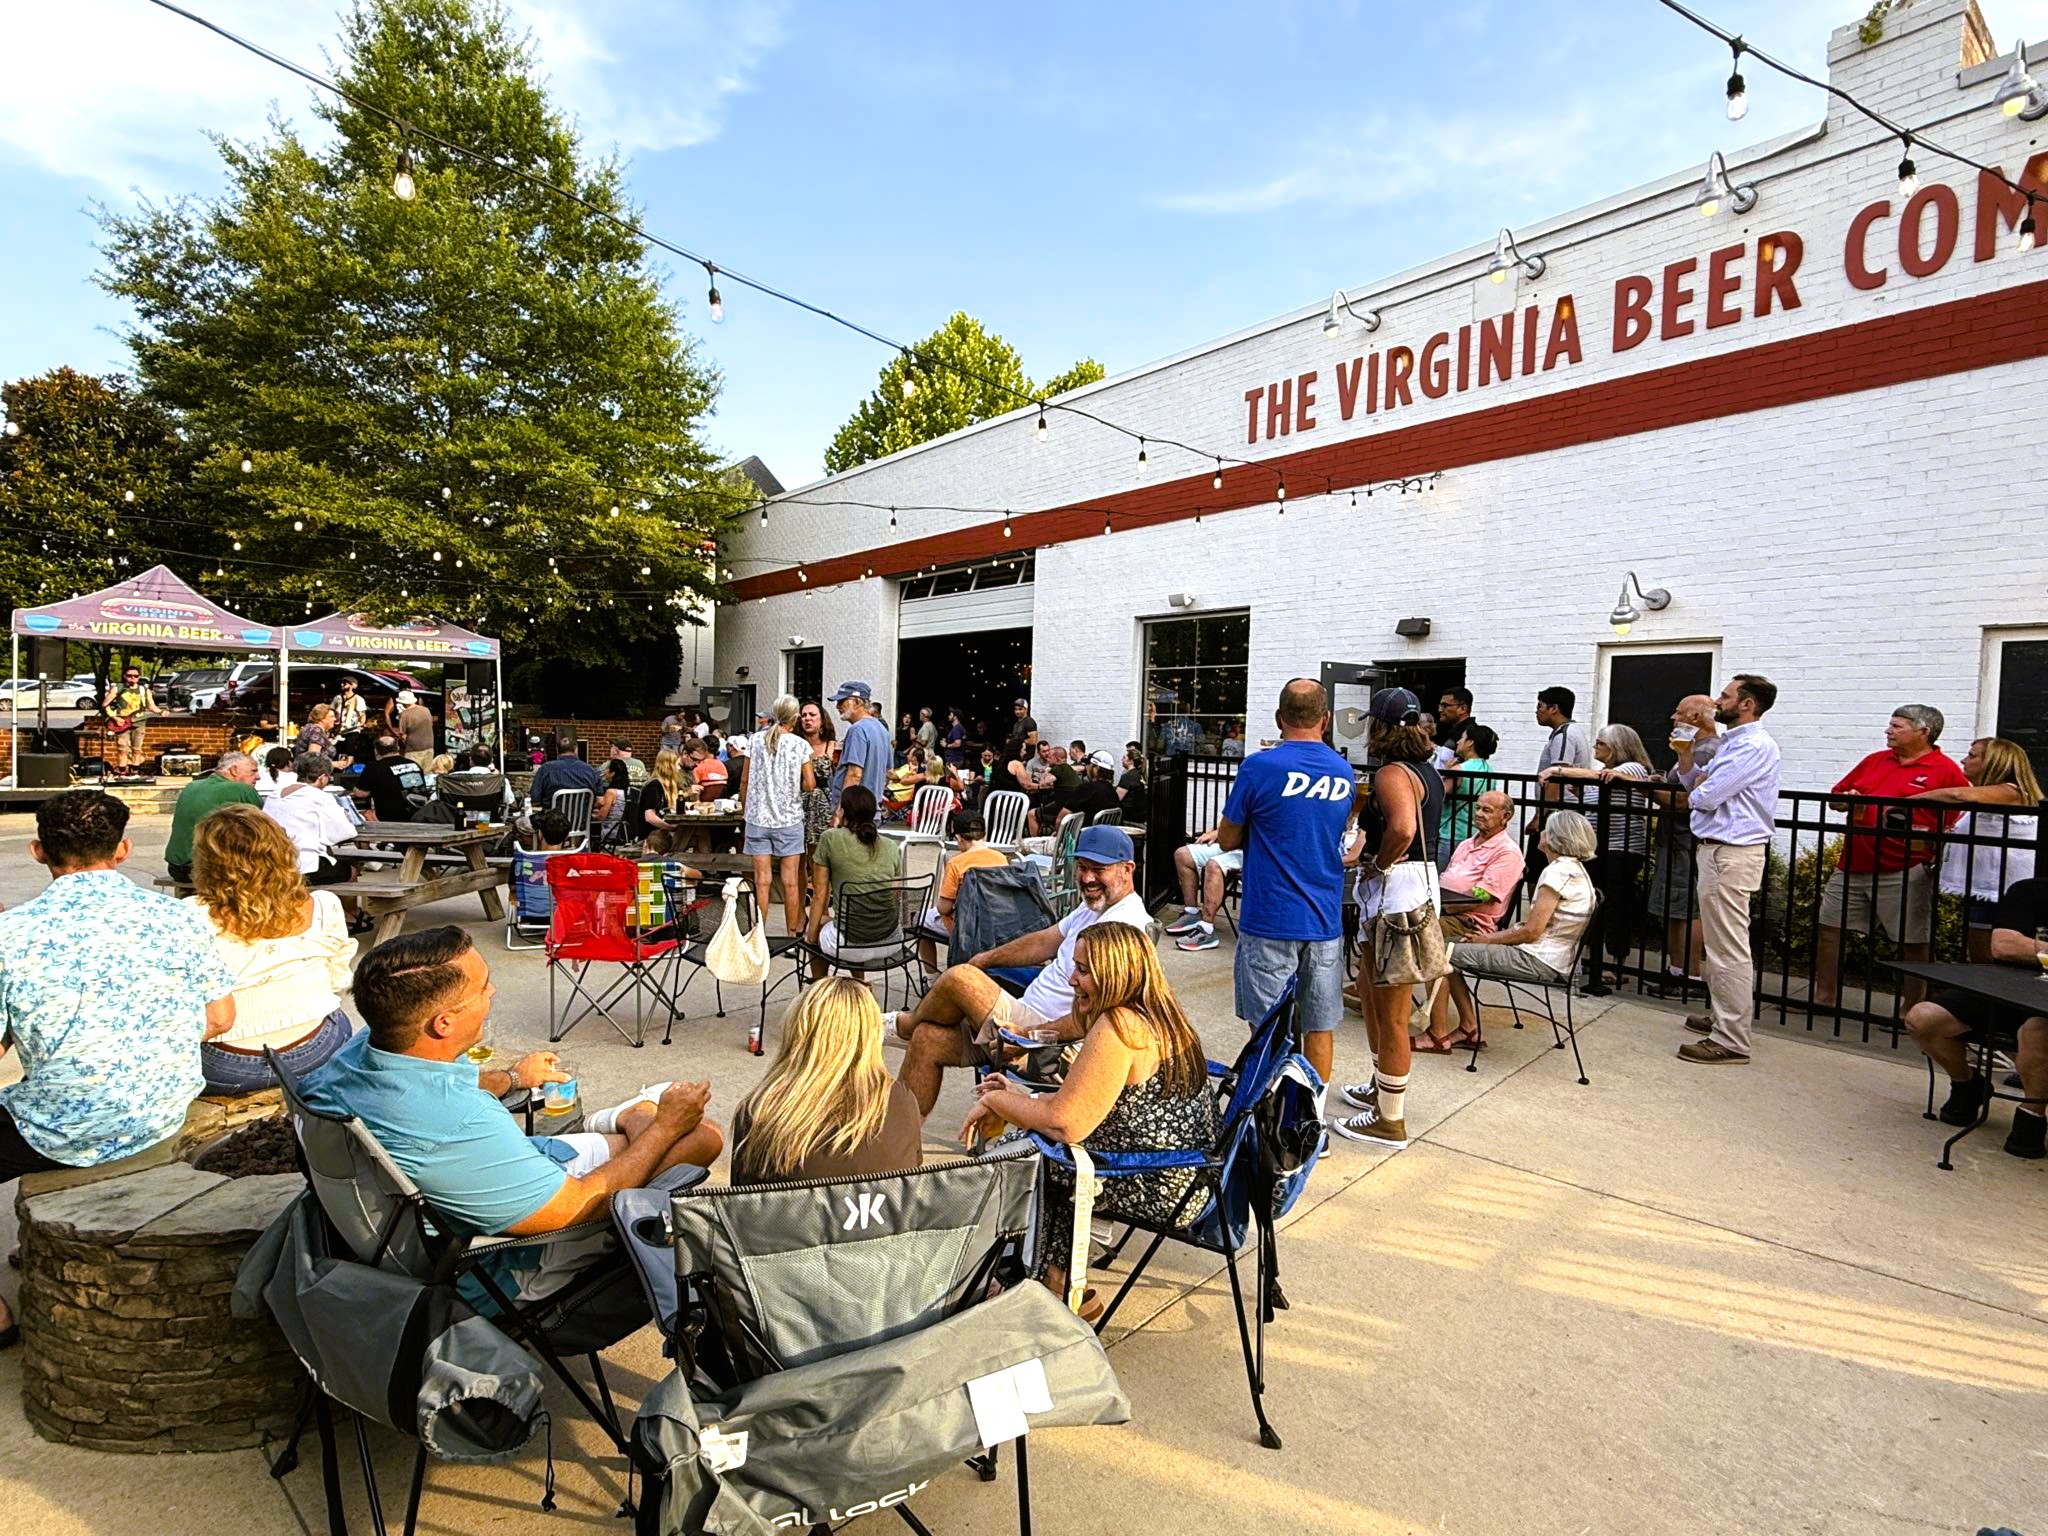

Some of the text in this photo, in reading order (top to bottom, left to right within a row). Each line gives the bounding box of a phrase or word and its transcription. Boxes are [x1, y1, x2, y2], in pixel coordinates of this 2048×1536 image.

[1244, 371, 1318, 444] THE
[1336, 292, 1583, 421] VIRGINIA
[1612, 230, 1805, 353] BEER
[89, 621, 175, 638] VIRGINIA
[178, 626, 222, 641] BEER
[344, 635, 413, 651] VIRGINIA
[416, 640, 452, 652] BEER
[1281, 772, 1351, 801] DAD
